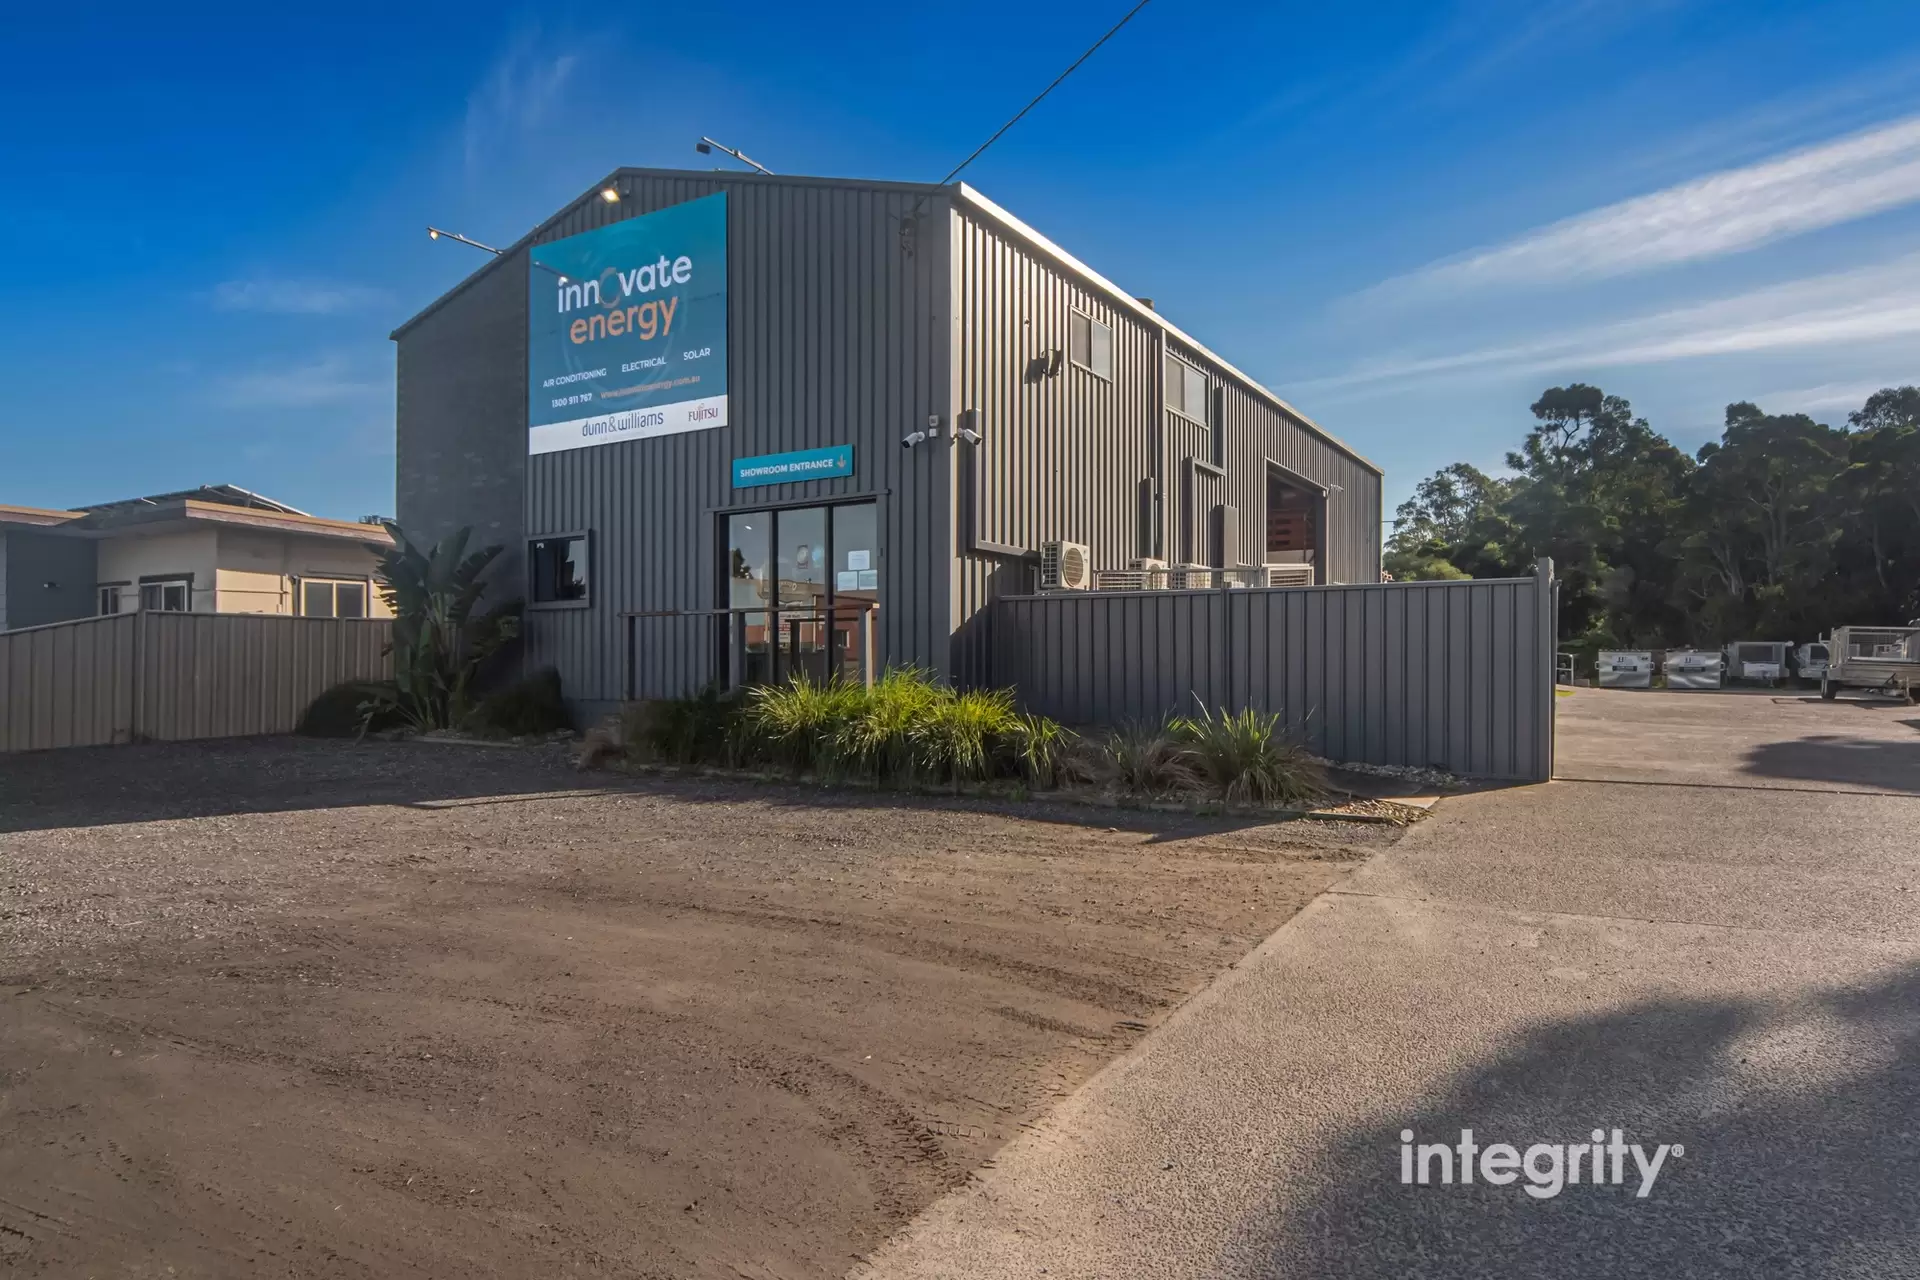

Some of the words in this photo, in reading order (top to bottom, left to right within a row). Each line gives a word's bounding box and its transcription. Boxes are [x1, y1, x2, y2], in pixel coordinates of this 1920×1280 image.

[569, 295, 678, 345] energy
[683, 347, 711, 361] SOLAR
[622, 357, 666, 372] ELECTRICAL
[542, 379, 555, 388] AIR
[555, 368, 607, 386] CONDITIONING
[551, 397, 567, 409] 1300
[568, 395, 579, 405] 911
[579, 392, 593, 403] 767
[688, 407, 719, 422] FUJITSU
[740, 465, 788, 477] SHOWROOM
[789, 459, 833, 472] ENTRANCE
